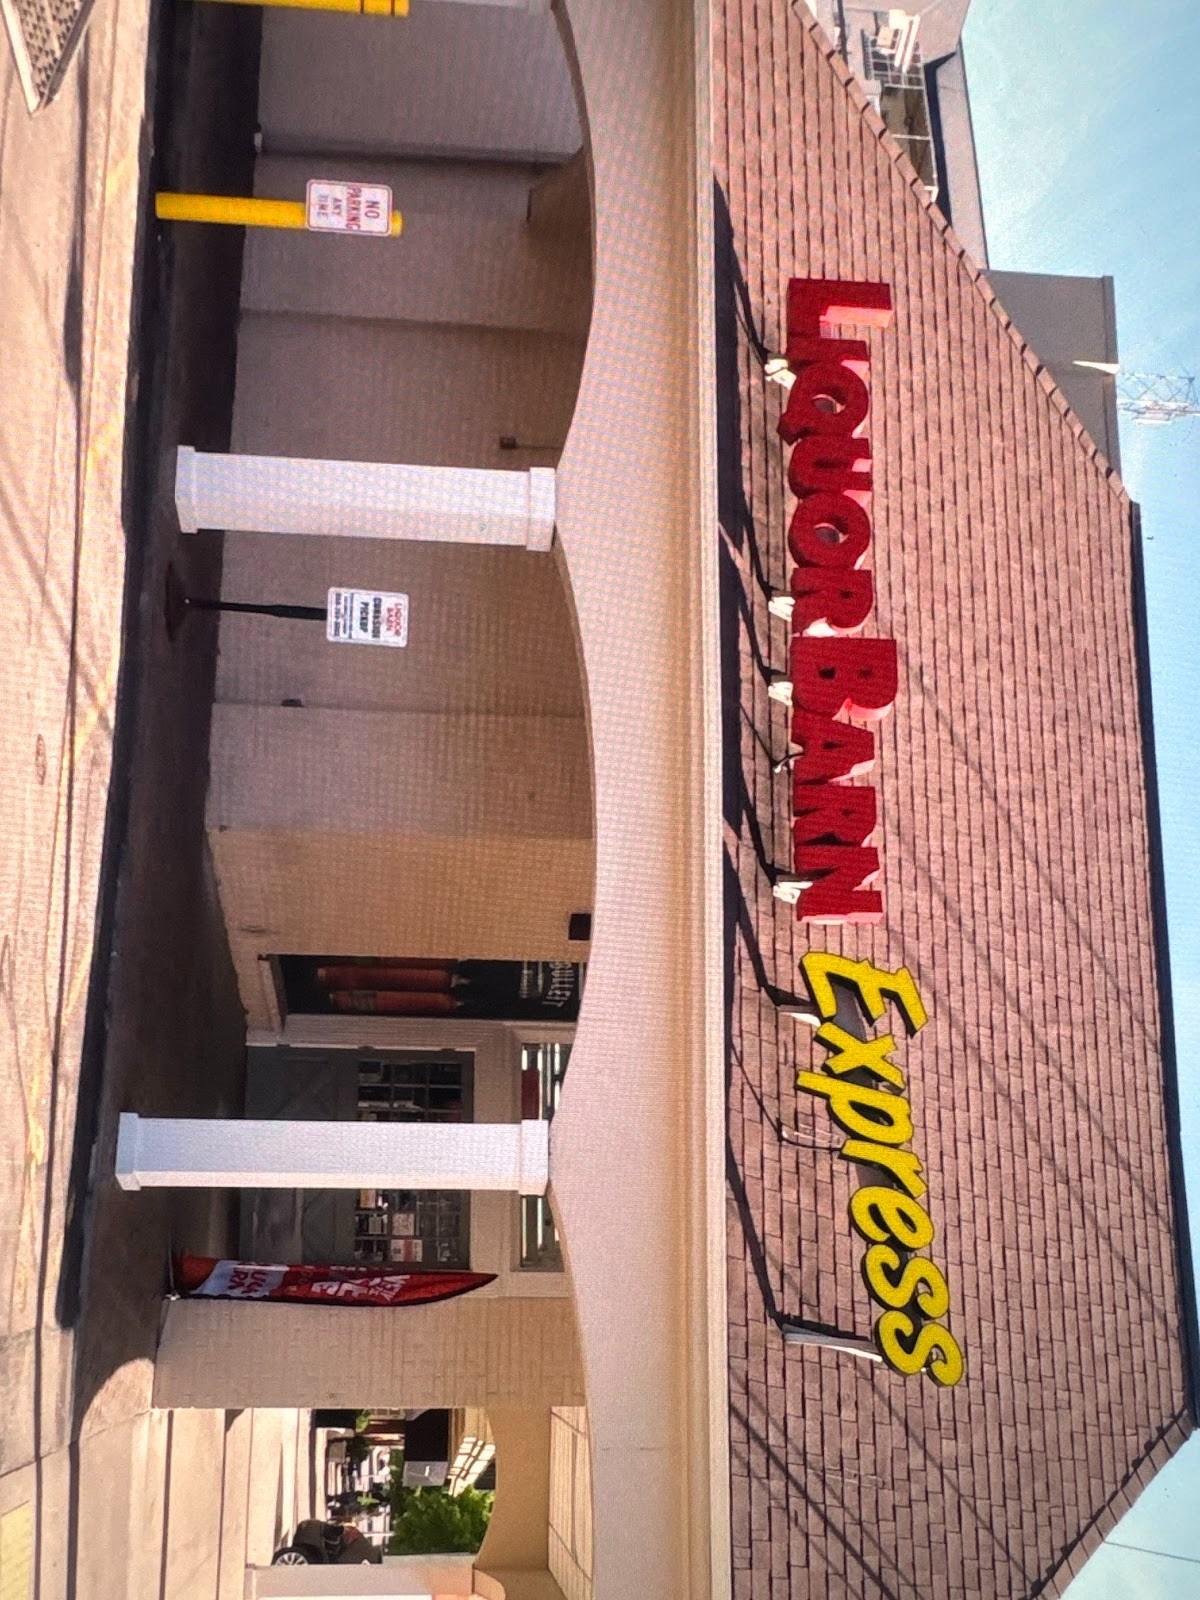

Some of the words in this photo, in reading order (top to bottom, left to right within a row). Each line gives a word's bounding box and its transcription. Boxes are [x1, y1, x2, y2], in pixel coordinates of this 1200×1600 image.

[316, 194, 329, 218] TIME
[331, 197, 342, 216] ANY
[345, 184, 361, 230] PARKING
[364, 200, 380, 219] NO
[359, 601, 369, 633] PICKUP
[790, 636, 898, 925] BARN
[796, 951, 965, 1387] Express
